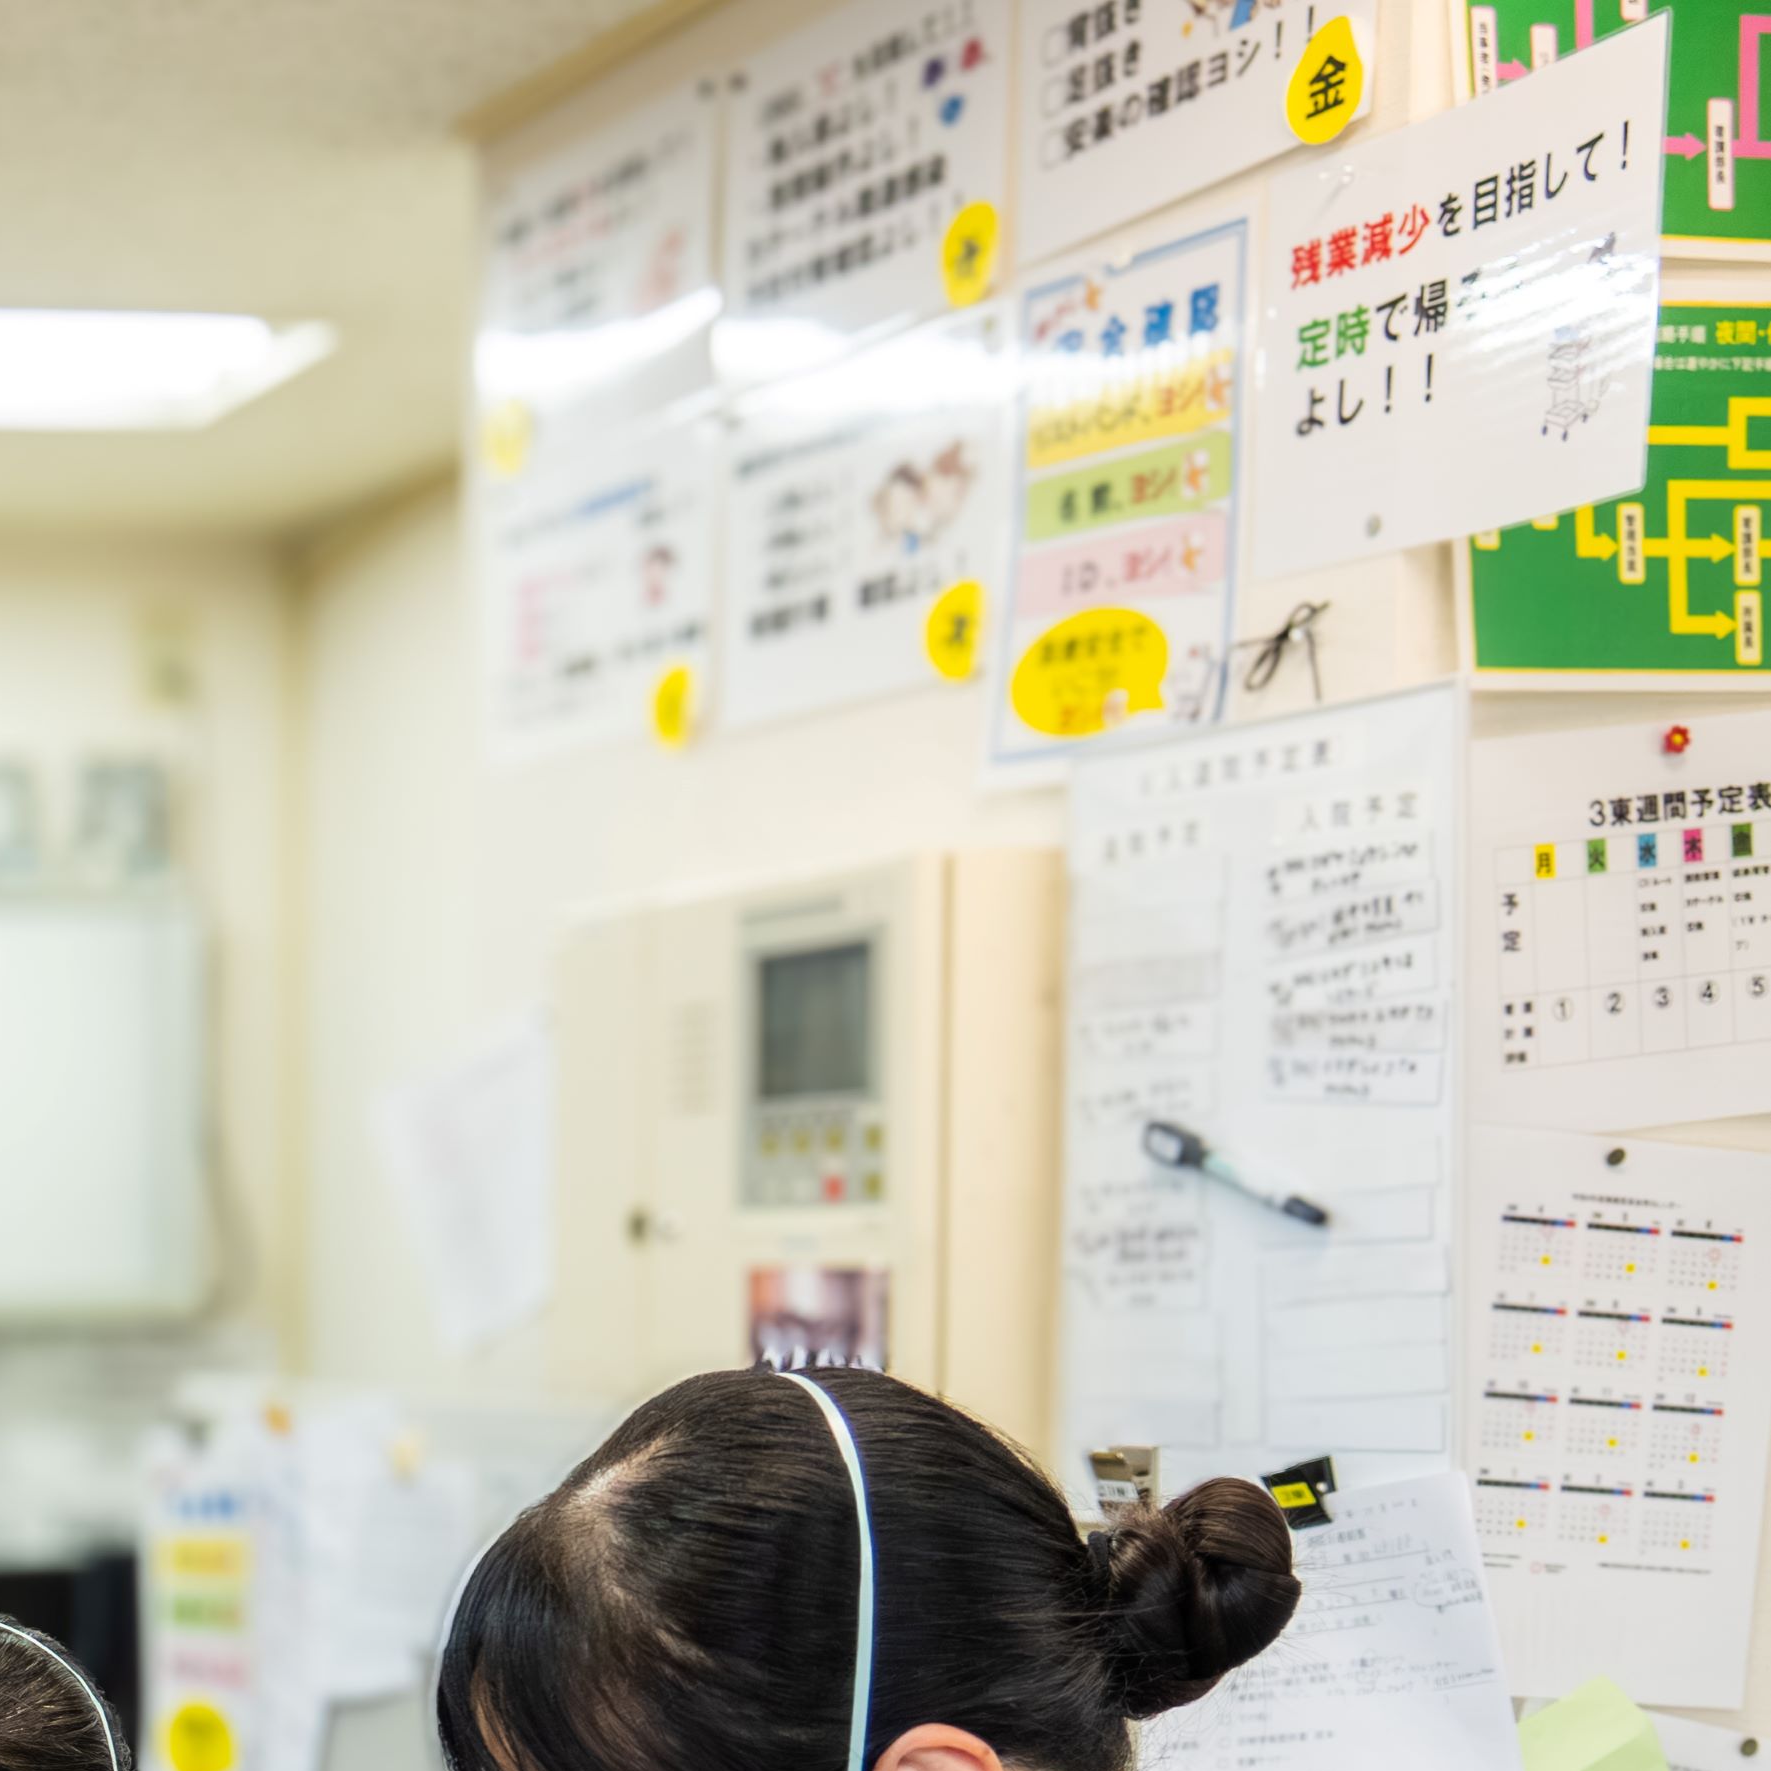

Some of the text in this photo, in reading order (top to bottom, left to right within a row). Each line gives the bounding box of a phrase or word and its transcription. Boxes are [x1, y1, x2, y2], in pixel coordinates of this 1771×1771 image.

[1306, 55, 1347, 120] 金
[1290, 119, 1632, 291] 残業減少を目指して！
[1294, 353, 1436, 438] よし！！
[1589, 783, 1771, 827] 3東週間予定表
[1536, 852, 1553, 874] 月
[1638, 842, 1656, 864] 水
[1684, 836, 1702, 859] 木
